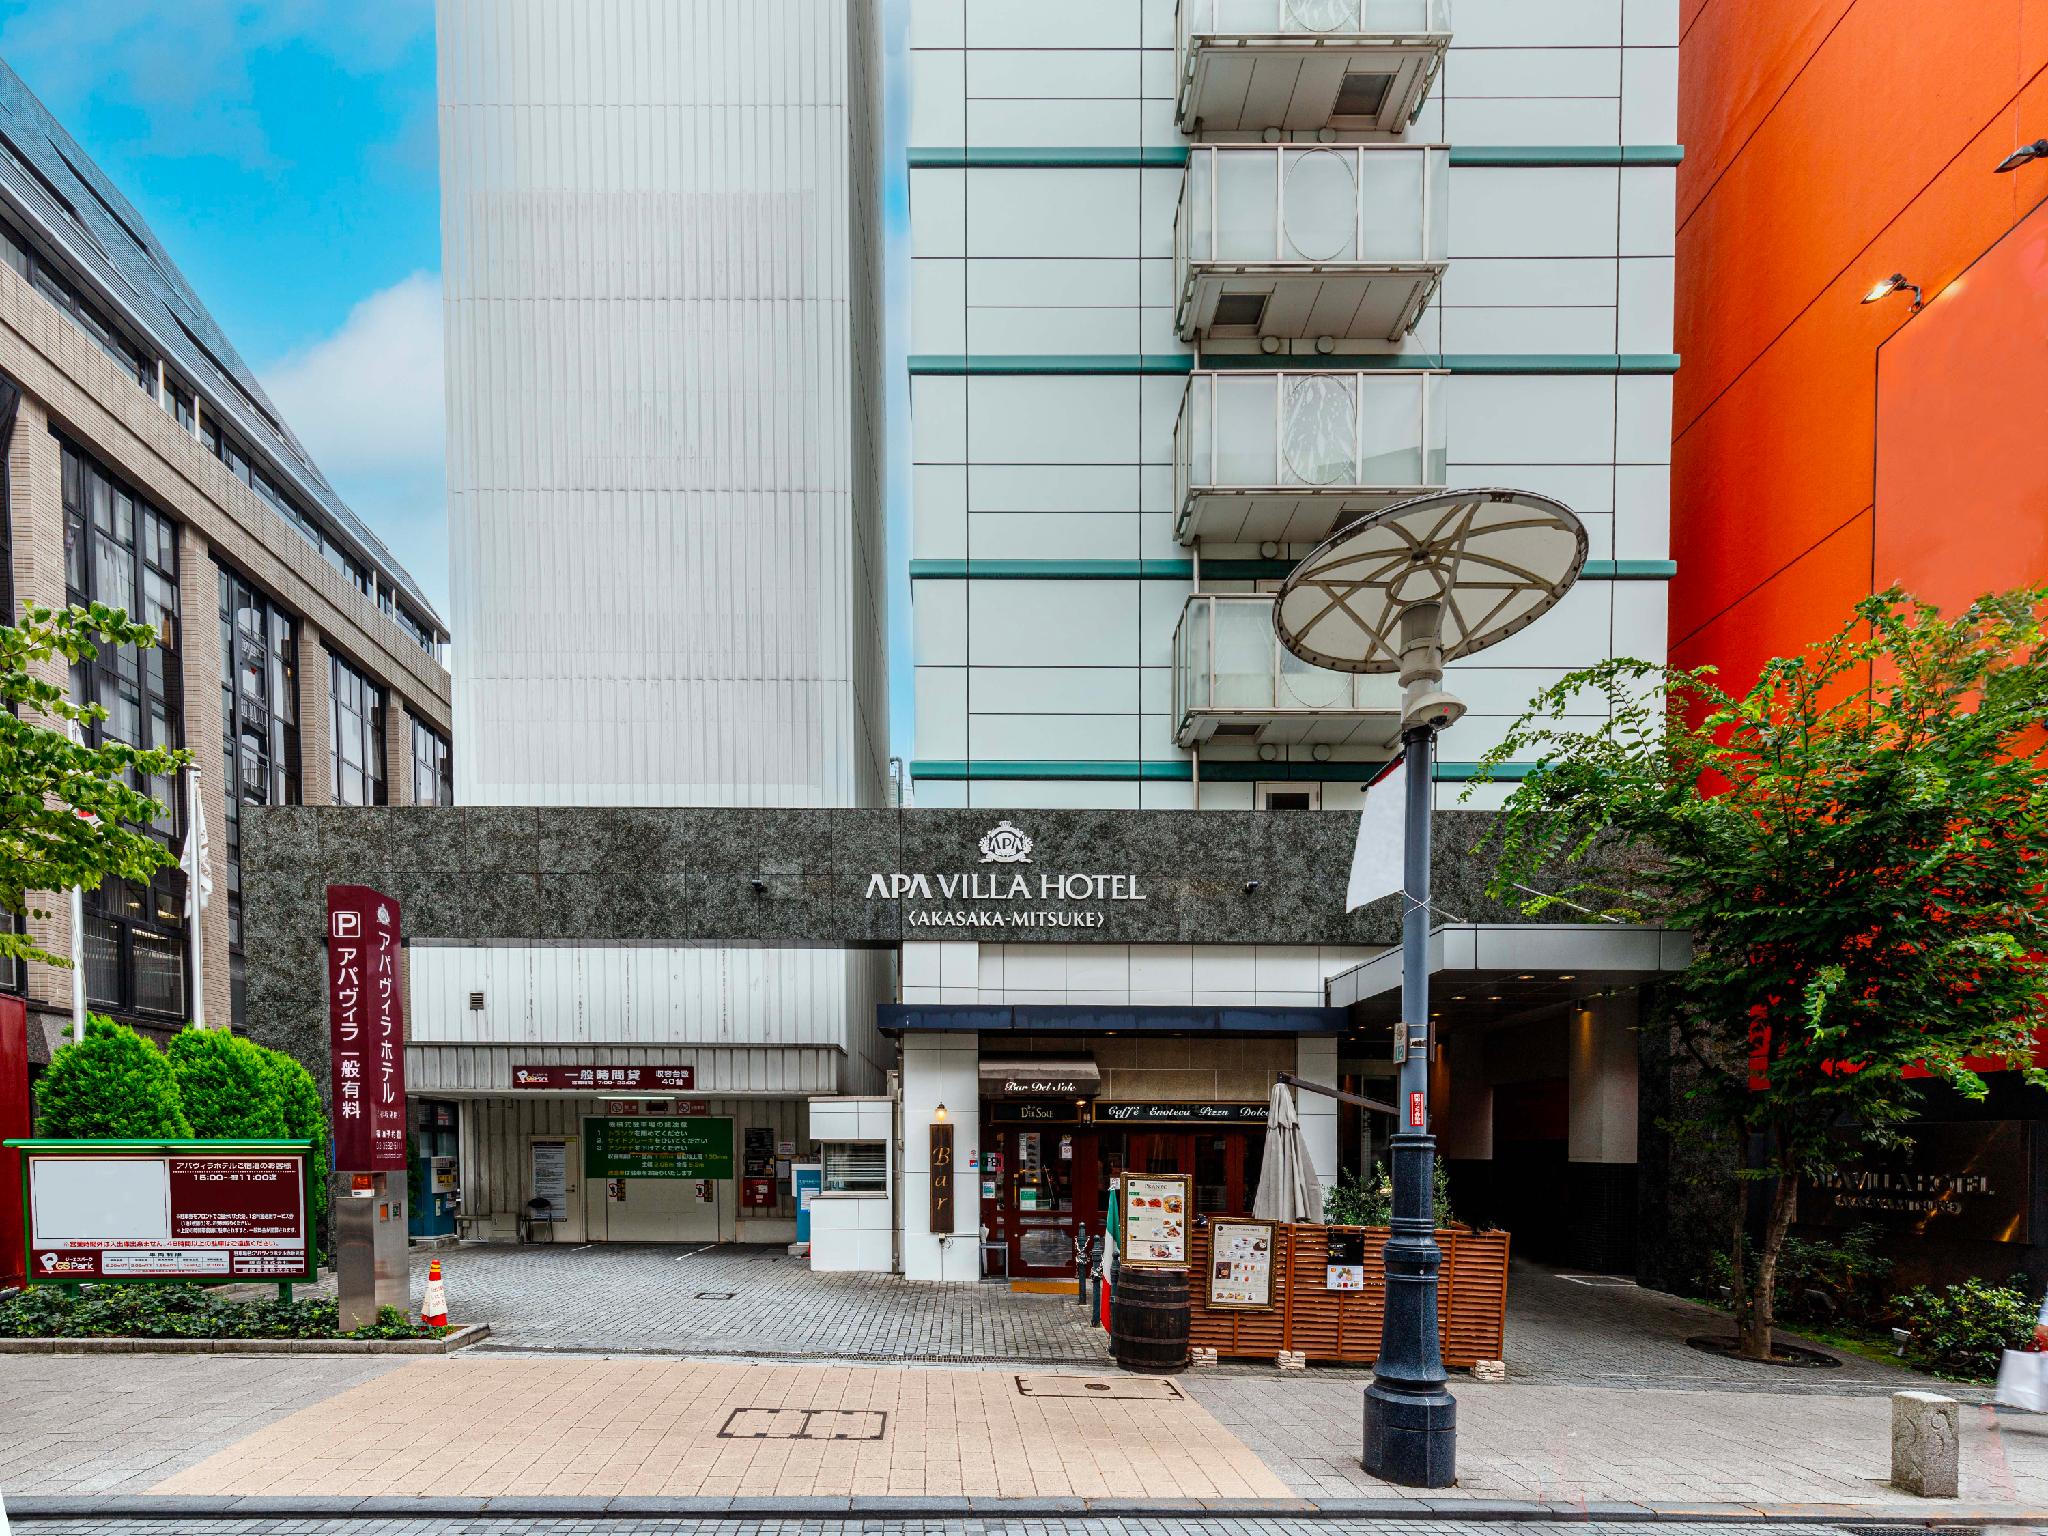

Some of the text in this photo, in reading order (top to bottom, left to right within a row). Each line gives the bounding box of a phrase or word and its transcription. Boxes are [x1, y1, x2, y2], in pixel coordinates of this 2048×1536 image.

[865, 873, 1147, 900] APA VILLA HOTEL
[338, 947, 361, 1119] アパヴィラ 一般有料
[565, 1069, 641, 1080] 一般時間貸
[1005, 1082, 1028, 1091] Bar
[1031, 1082, 1051, 1092] Del
[932, 1146, 951, 1212] Bar
